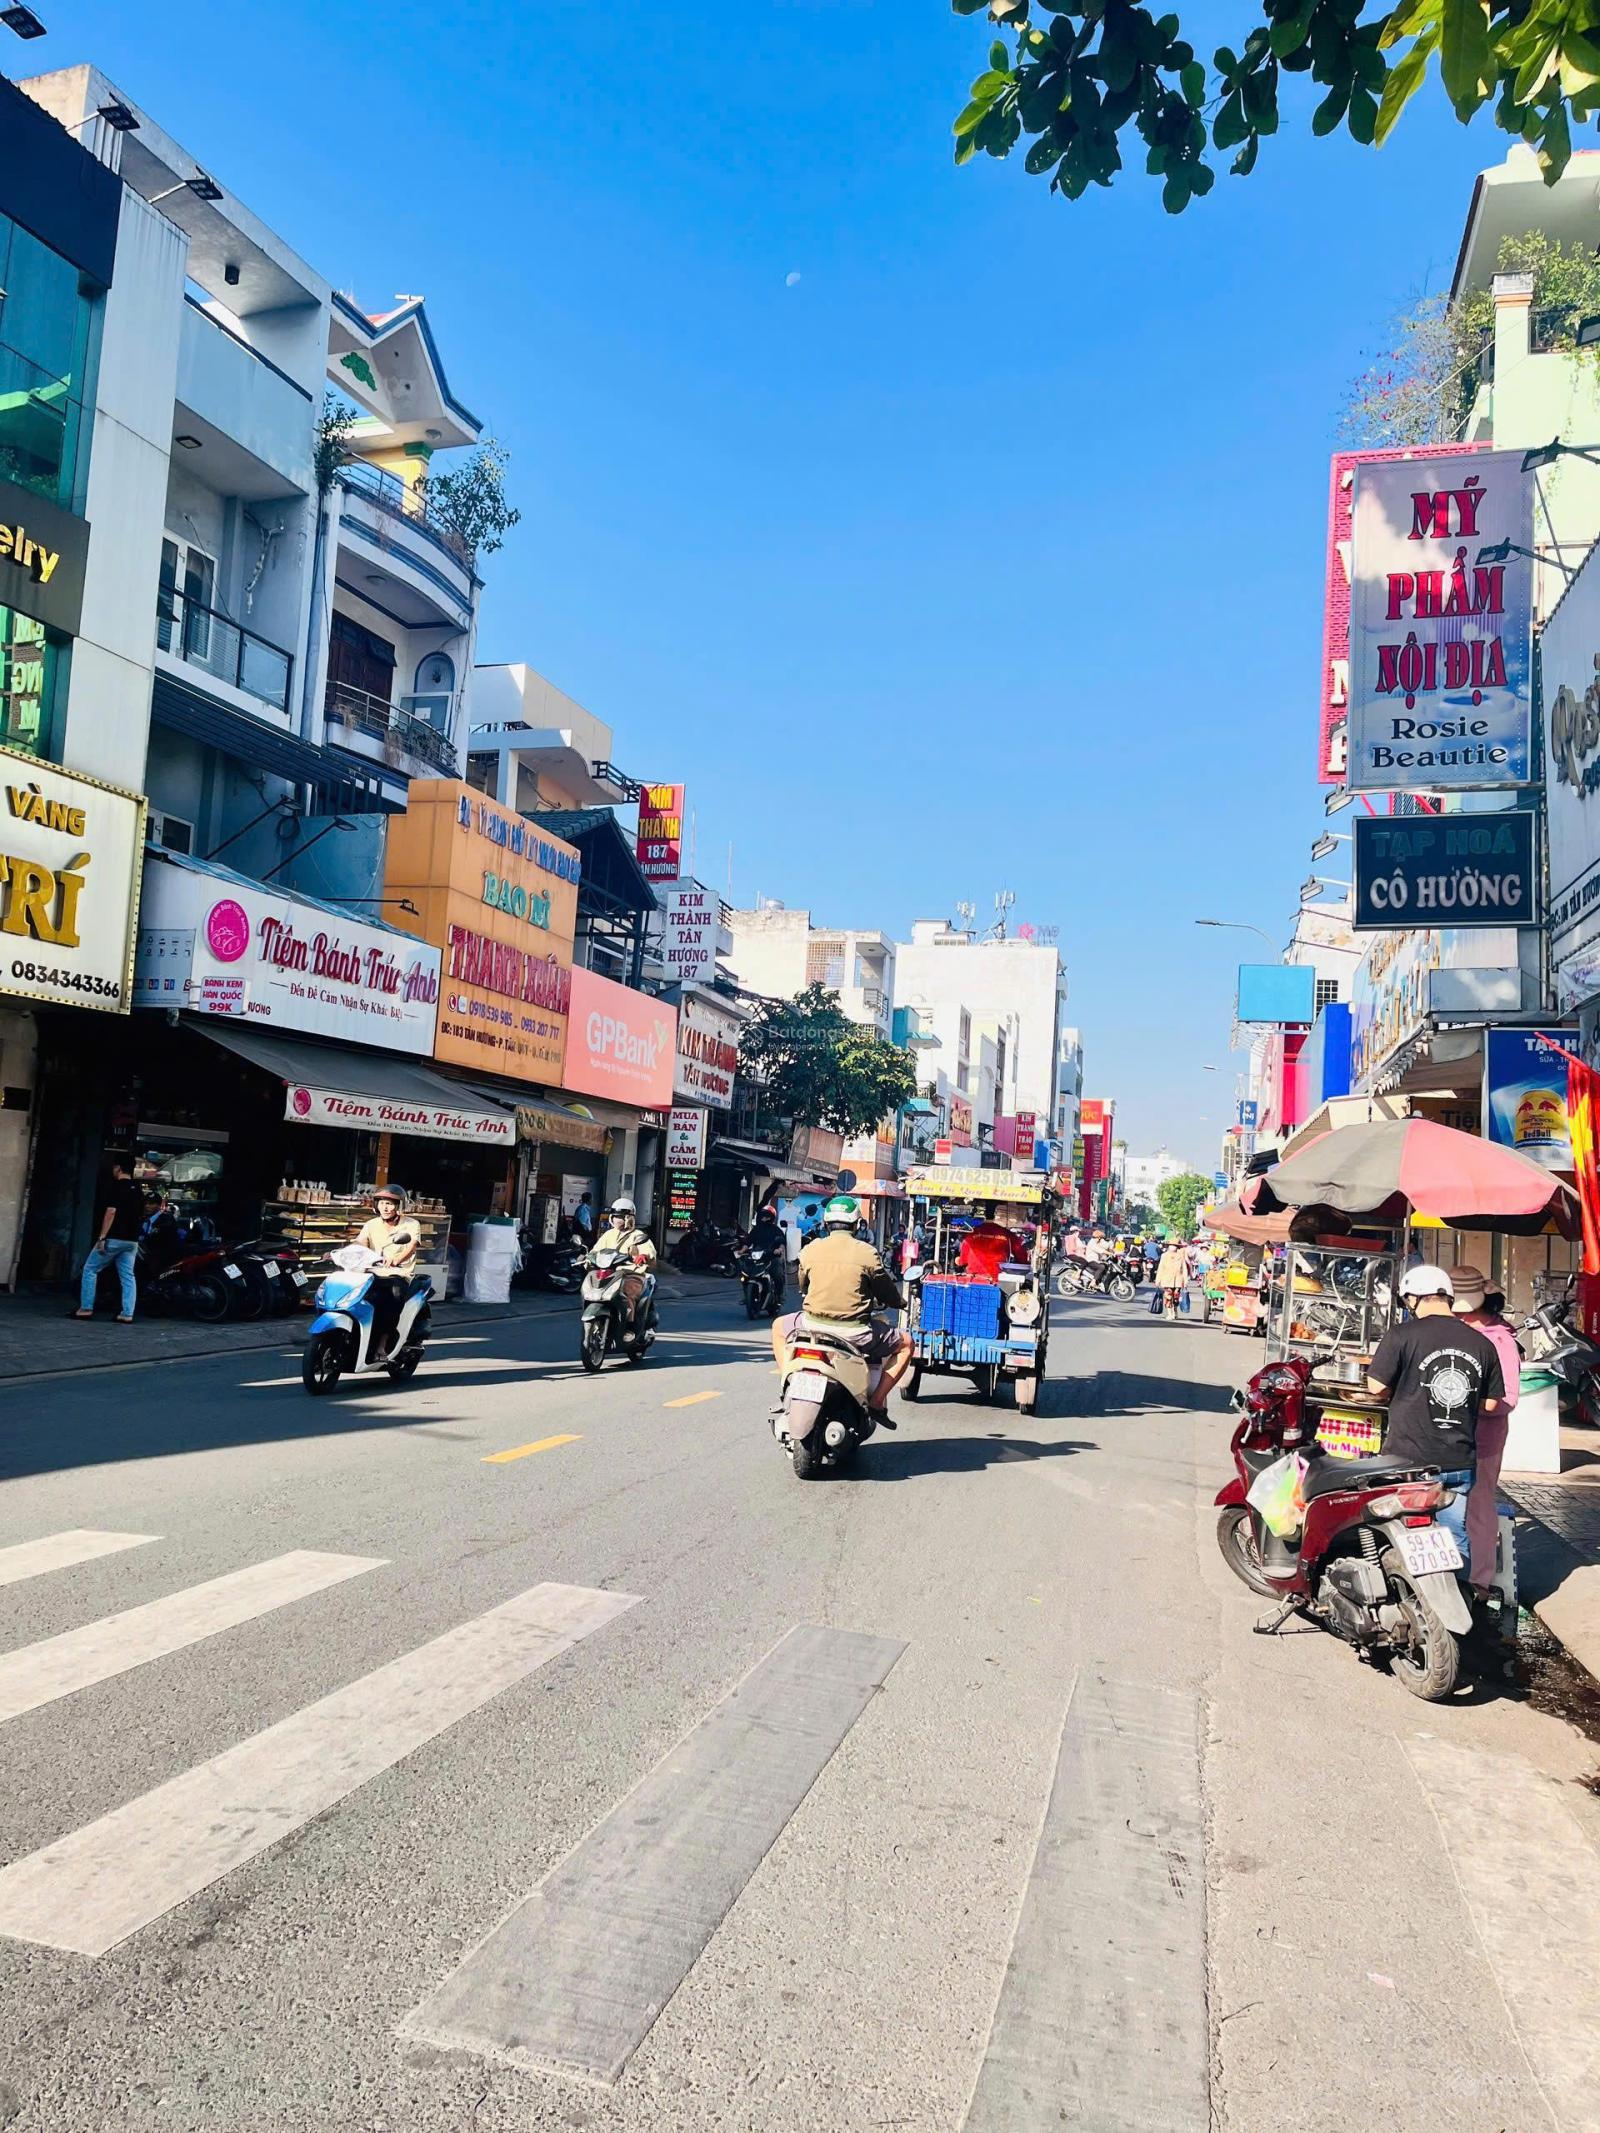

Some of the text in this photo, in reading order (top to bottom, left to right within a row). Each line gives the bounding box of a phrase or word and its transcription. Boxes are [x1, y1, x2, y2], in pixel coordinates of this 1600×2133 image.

[1408, 476, 1487, 541] MỸ
[1386, 546, 1505, 620] PHẨM
[1375, 632, 1508, 709] NỘI ĐỊA
[1391, 717, 1489, 740] Rosie
[1372, 745, 1508, 769] Beautie
[6, 783, 86, 837] VÀNG
[648, 786, 674, 810] KIM
[647, 844, 668, 859] 187
[1371, 822, 1515, 863] TẠP HOÁ
[0, 852, 91, 948] RÍ
[482, 871, 527, 918] BAO
[679, 894, 704, 907] KIM
[1369, 868, 1522, 909] CÔ HƯỜNG
[669, 909, 711, 925] THÀNH
[678, 931, 701, 943] TÂN
[258, 917, 437, 1004] Tiệm Bánh Trúc Anh
[668, 949, 709, 962] HƯƠNG
[11, 960, 120, 999] 0834343366
[677, 966, 698, 978] 187
[226, 981, 244, 990] KEM
[208, 1003, 232, 1012] 99K
[586, 1011, 657, 1070] GPBank
[679, 1024, 701, 1059] KIM
[324, 1096, 508, 1134] Tiệm Bánh Trúc Anh
[673, 1112, 698, 1120] MUA
[673, 1121, 697, 1131] BÁN
[668, 1154, 698, 1166] VÀNG
[671, 1142, 696, 1154] CẦM
